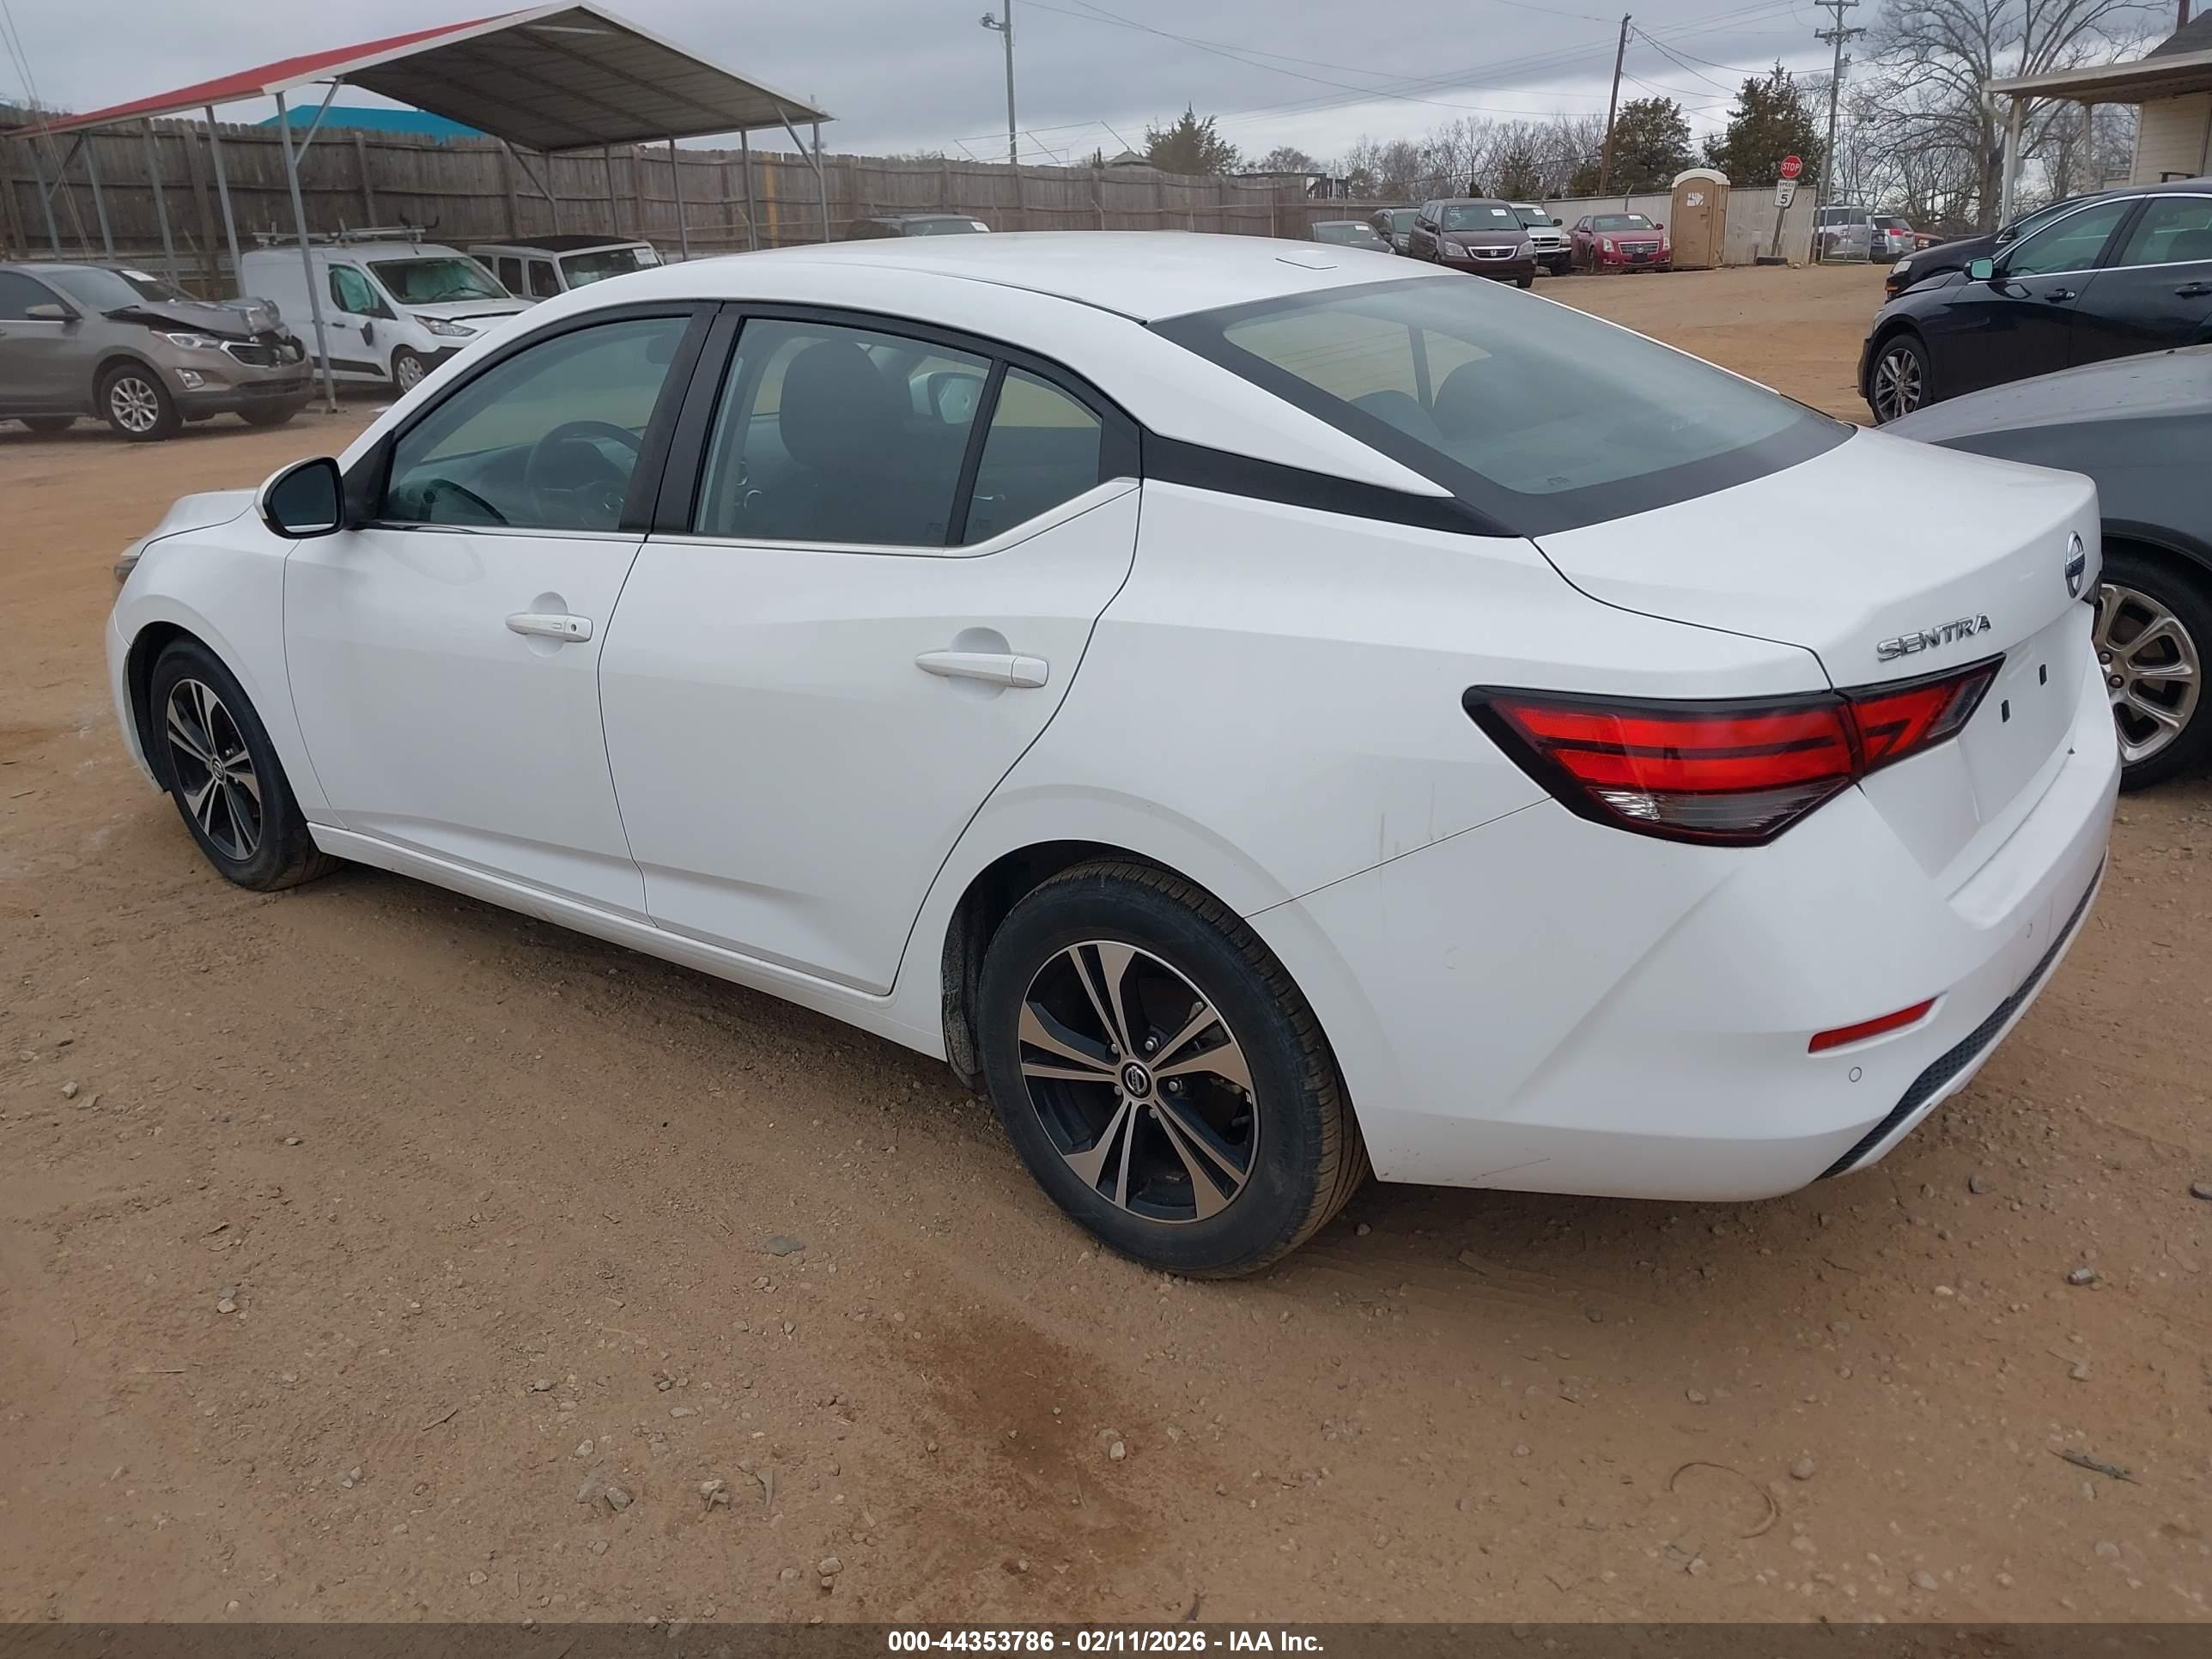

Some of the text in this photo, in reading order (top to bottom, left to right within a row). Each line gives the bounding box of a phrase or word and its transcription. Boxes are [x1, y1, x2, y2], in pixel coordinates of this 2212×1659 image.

[1782, 162, 1800, 172] STOP
[1780, 193, 1789, 204] 5
[1877, 612, 1992, 662] SENTRA
